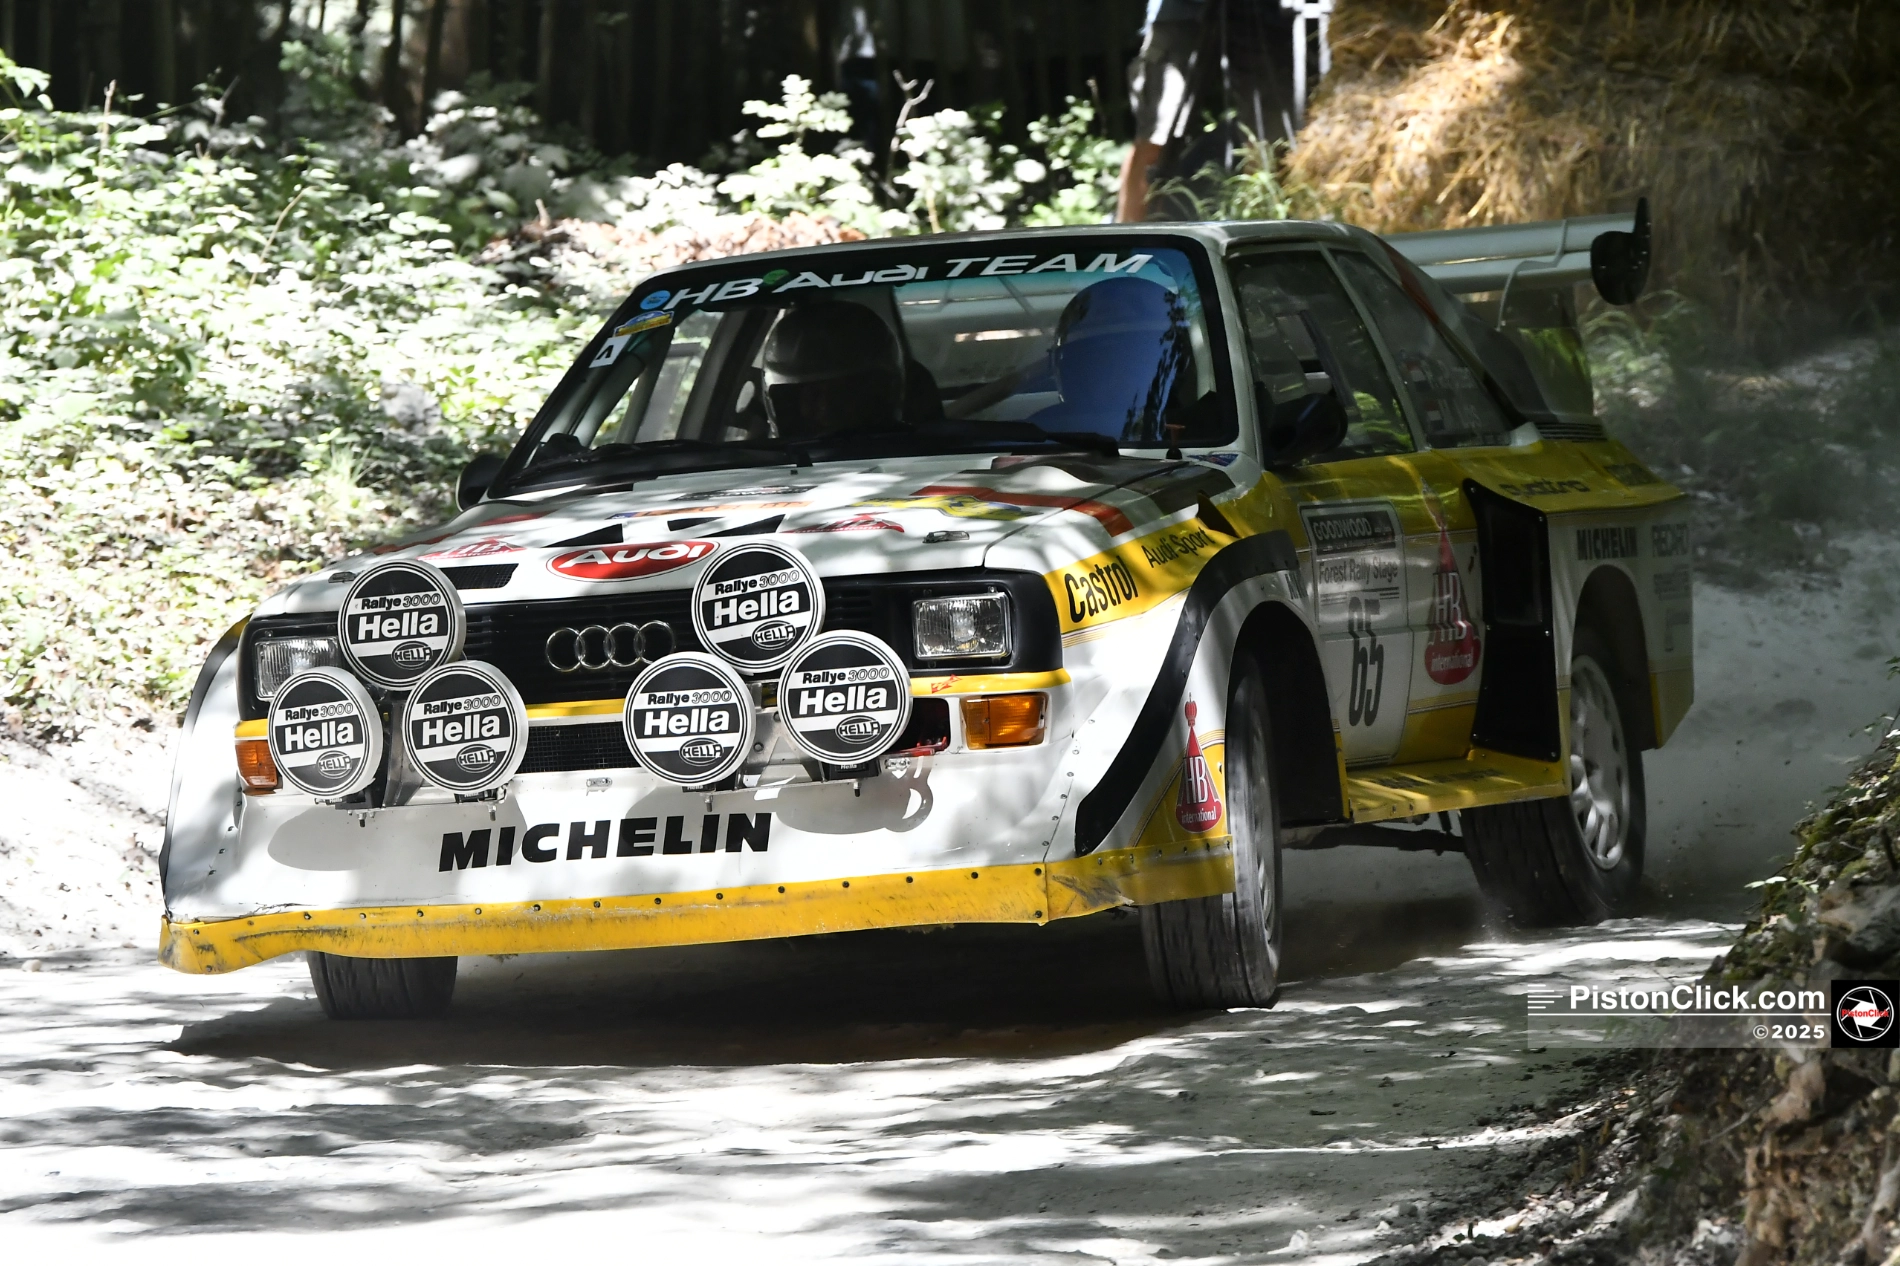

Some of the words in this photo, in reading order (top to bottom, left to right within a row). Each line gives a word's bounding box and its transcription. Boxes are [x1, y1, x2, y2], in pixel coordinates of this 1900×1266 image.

[663, 277, 763, 310] HB
[772, 264, 929, 293] Audi
[946, 253, 1154, 278] TEAM
[1312, 517, 1372, 541] GOODWOOD
[557, 544, 707, 569] Audi
[1318, 560, 1348, 585] Forest
[1350, 558, 1370, 585] Rally
[1373, 555, 1399, 582] Stage
[1064, 554, 1139, 624] Castrol
[713, 589, 800, 626] Hella
[357, 612, 439, 641] Hella
[754, 623, 796, 643] HELLA
[394, 646, 433, 662] HELLA
[1348, 596, 1385, 727] 65
[798, 686, 888, 715] Hella
[422, 714, 500, 746] Hella
[644, 709, 730, 736] Hella
[838, 721, 881, 737] HELLA
[284, 723, 354, 752] Hella
[682, 743, 724, 759] HELLA
[318, 755, 352, 771] HELLA
[459, 748, 497, 764] HELLA
[1185, 756, 1209, 804] HB
[1181, 806, 1217, 825] international
[438, 812, 772, 873] MICHELIN
